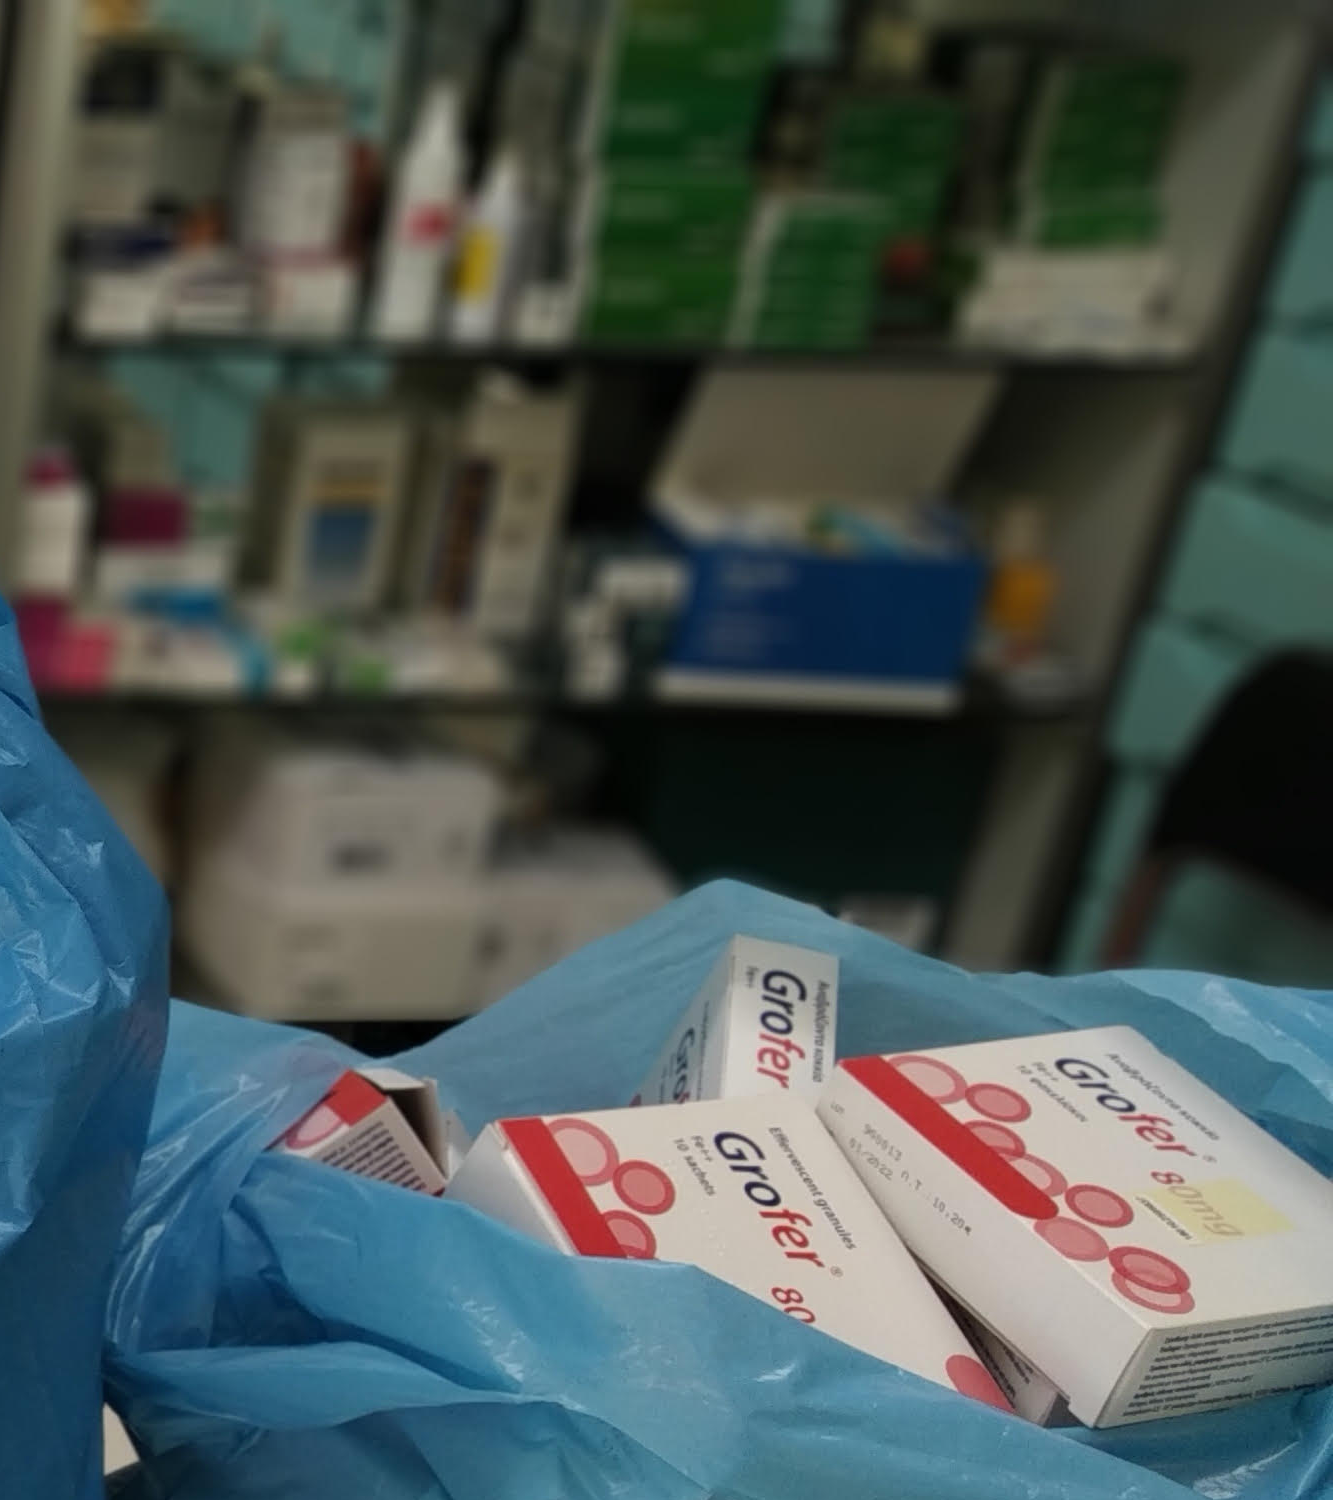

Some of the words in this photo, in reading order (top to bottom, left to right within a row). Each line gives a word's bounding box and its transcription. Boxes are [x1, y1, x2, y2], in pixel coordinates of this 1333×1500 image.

[757, 968, 807, 1089] Grofer
[1054, 1057, 1197, 1157] Grofer
[713, 1131, 826, 1268] Grofer
[768, 1126, 824, 1197] Effervescent
[813, 1197, 858, 1251] granules
